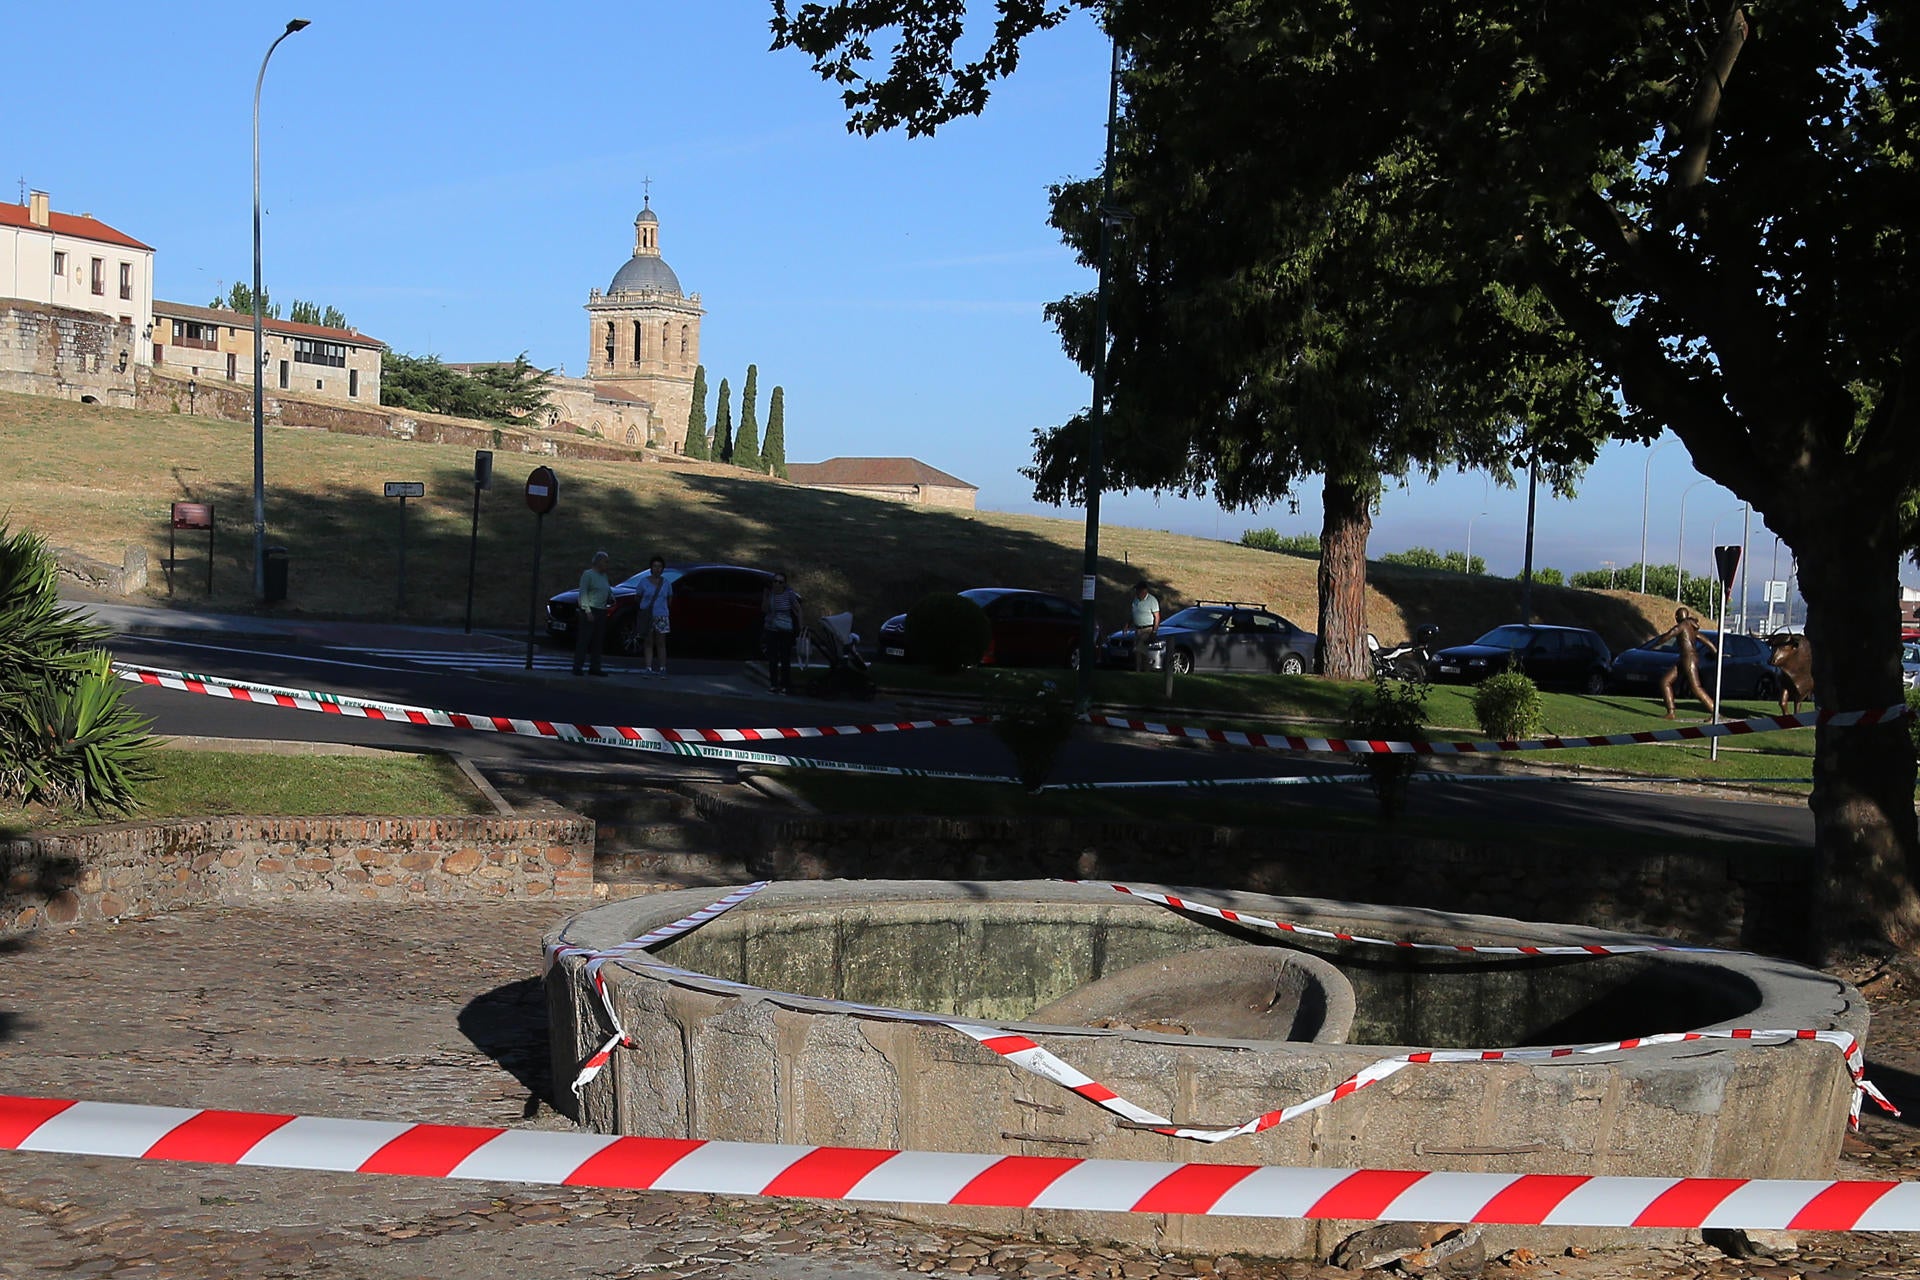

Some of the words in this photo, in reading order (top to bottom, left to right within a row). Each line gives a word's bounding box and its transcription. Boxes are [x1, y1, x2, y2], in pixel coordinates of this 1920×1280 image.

[619, 738, 634, 747] CIVIL
[635, 740, 662, 750] GUARDIA
[702, 747, 723, 756] PASAR
[724, 750, 733, 758] NO
[735, 750, 749, 760] CIVIL
[750, 752, 777, 762] GUARDIA
